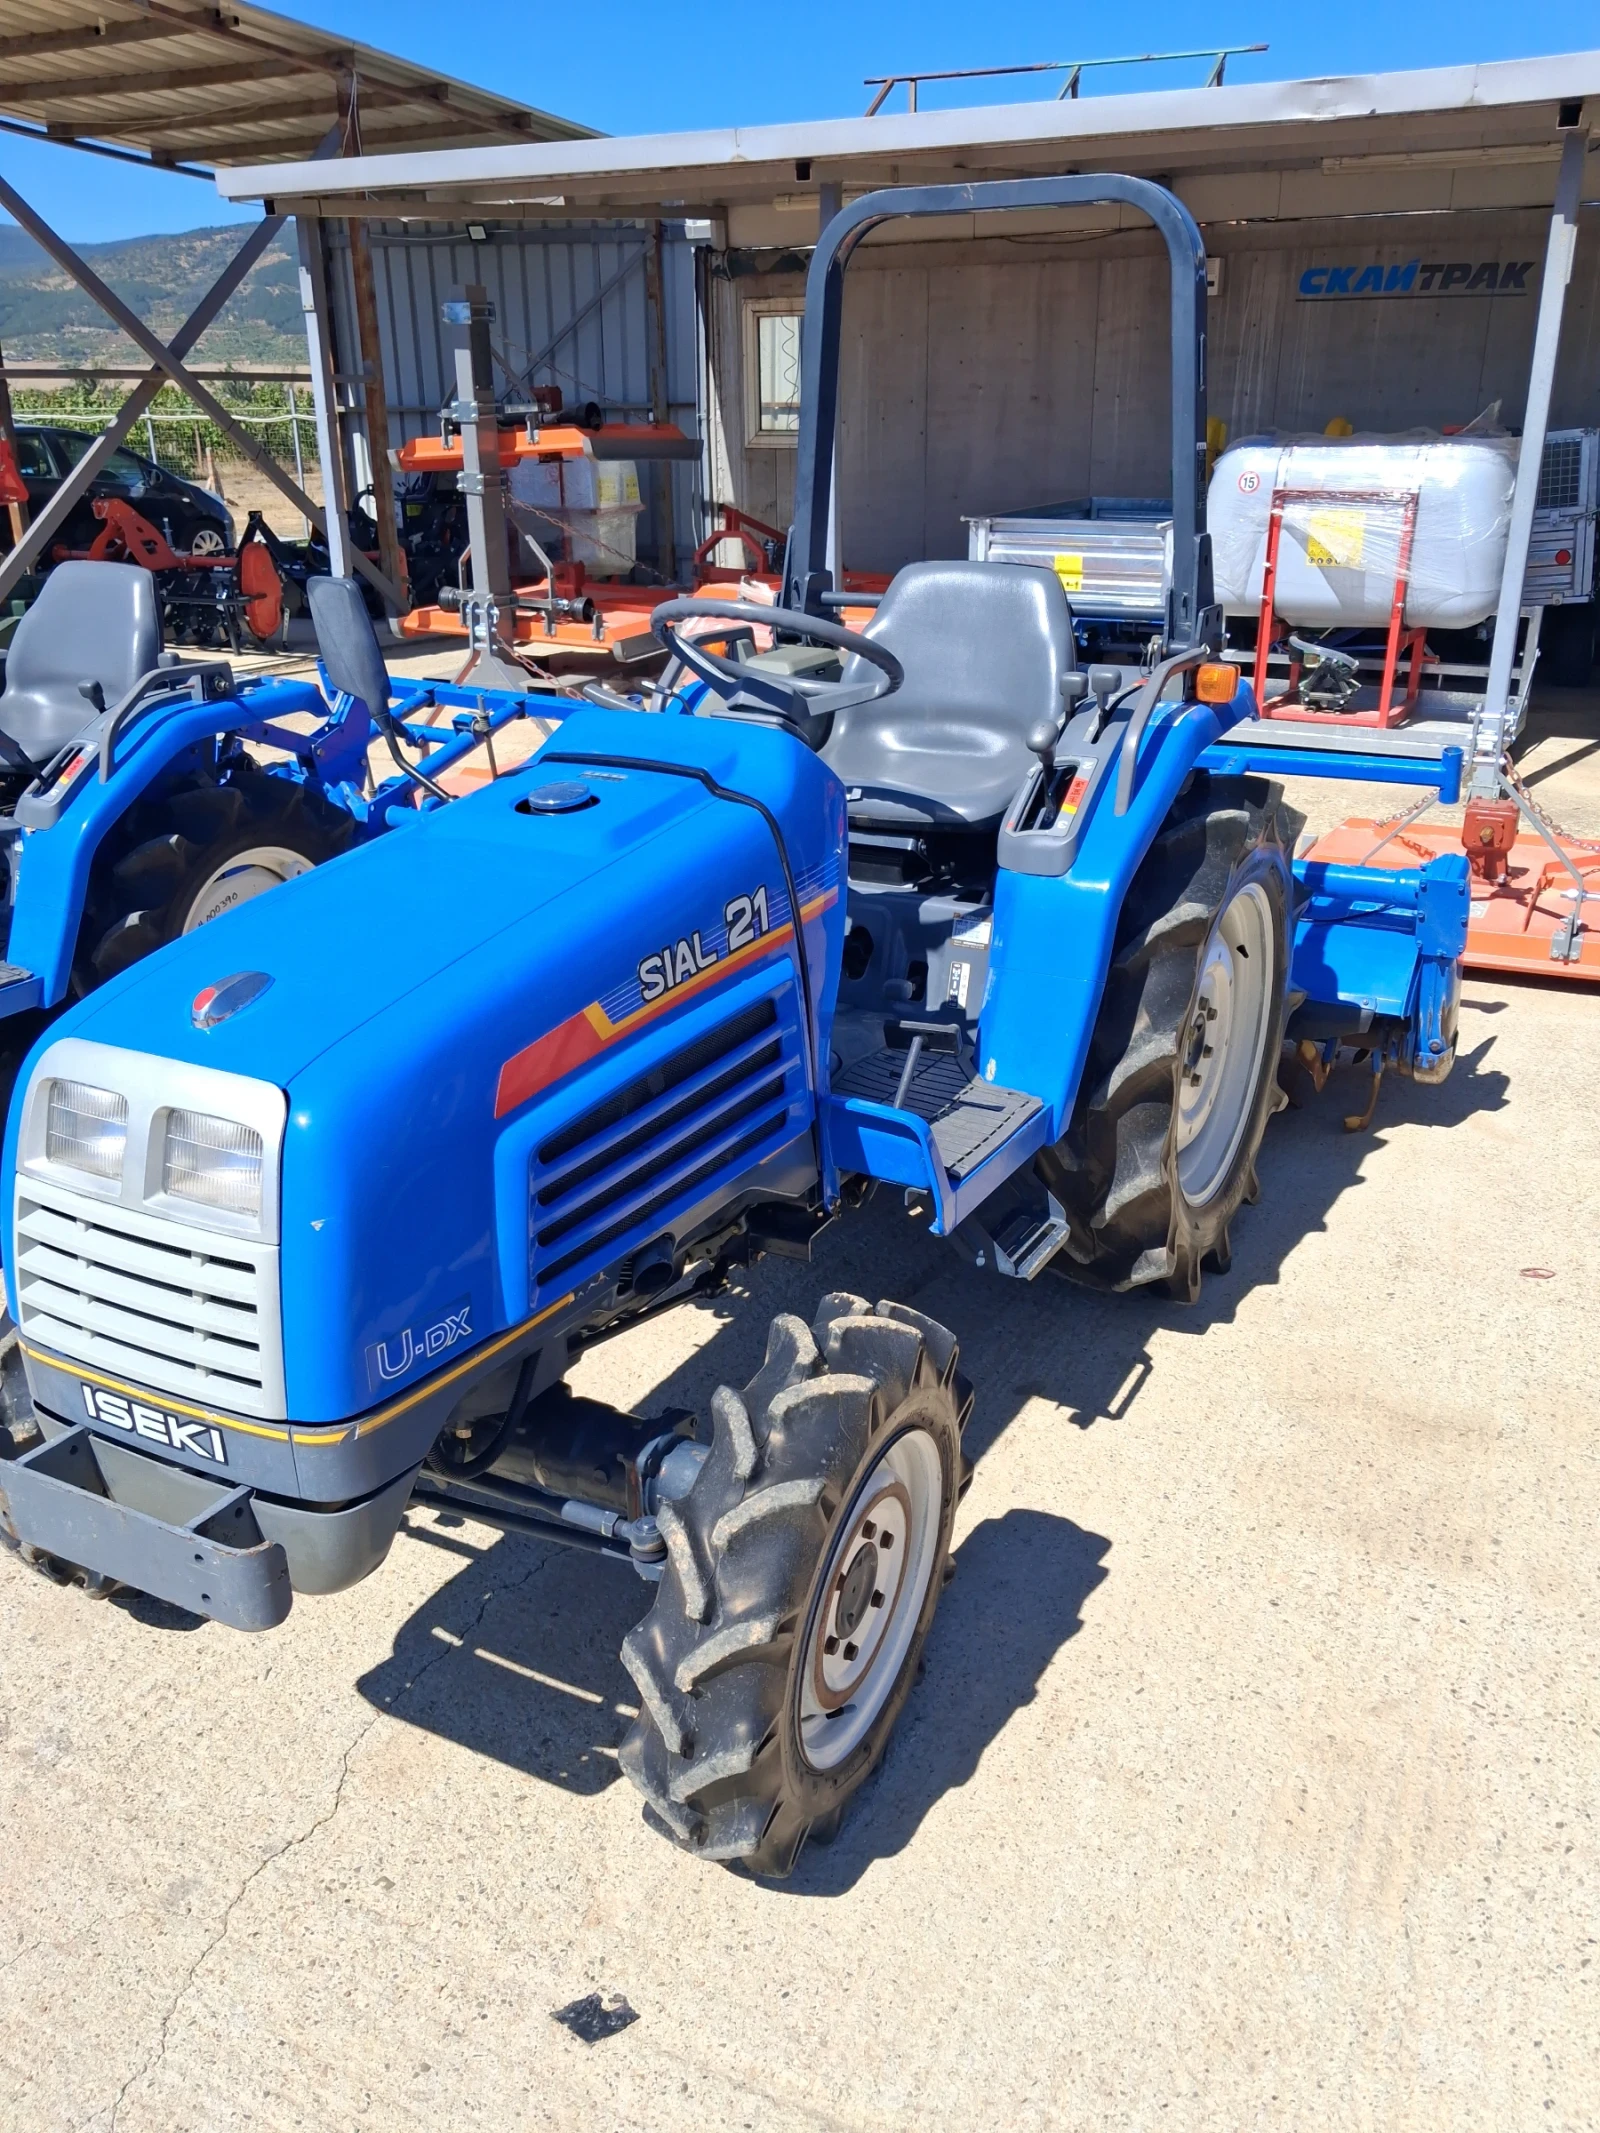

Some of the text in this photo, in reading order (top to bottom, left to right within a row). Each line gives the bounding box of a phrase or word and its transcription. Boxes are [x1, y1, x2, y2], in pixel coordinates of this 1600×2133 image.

[1299, 259, 1536, 295] СКАЙТРАК
[1243, 476, 1256, 489] 15
[638, 885, 770, 1002] SIAL 21
[81, 1382, 228, 1465] ISEKI
